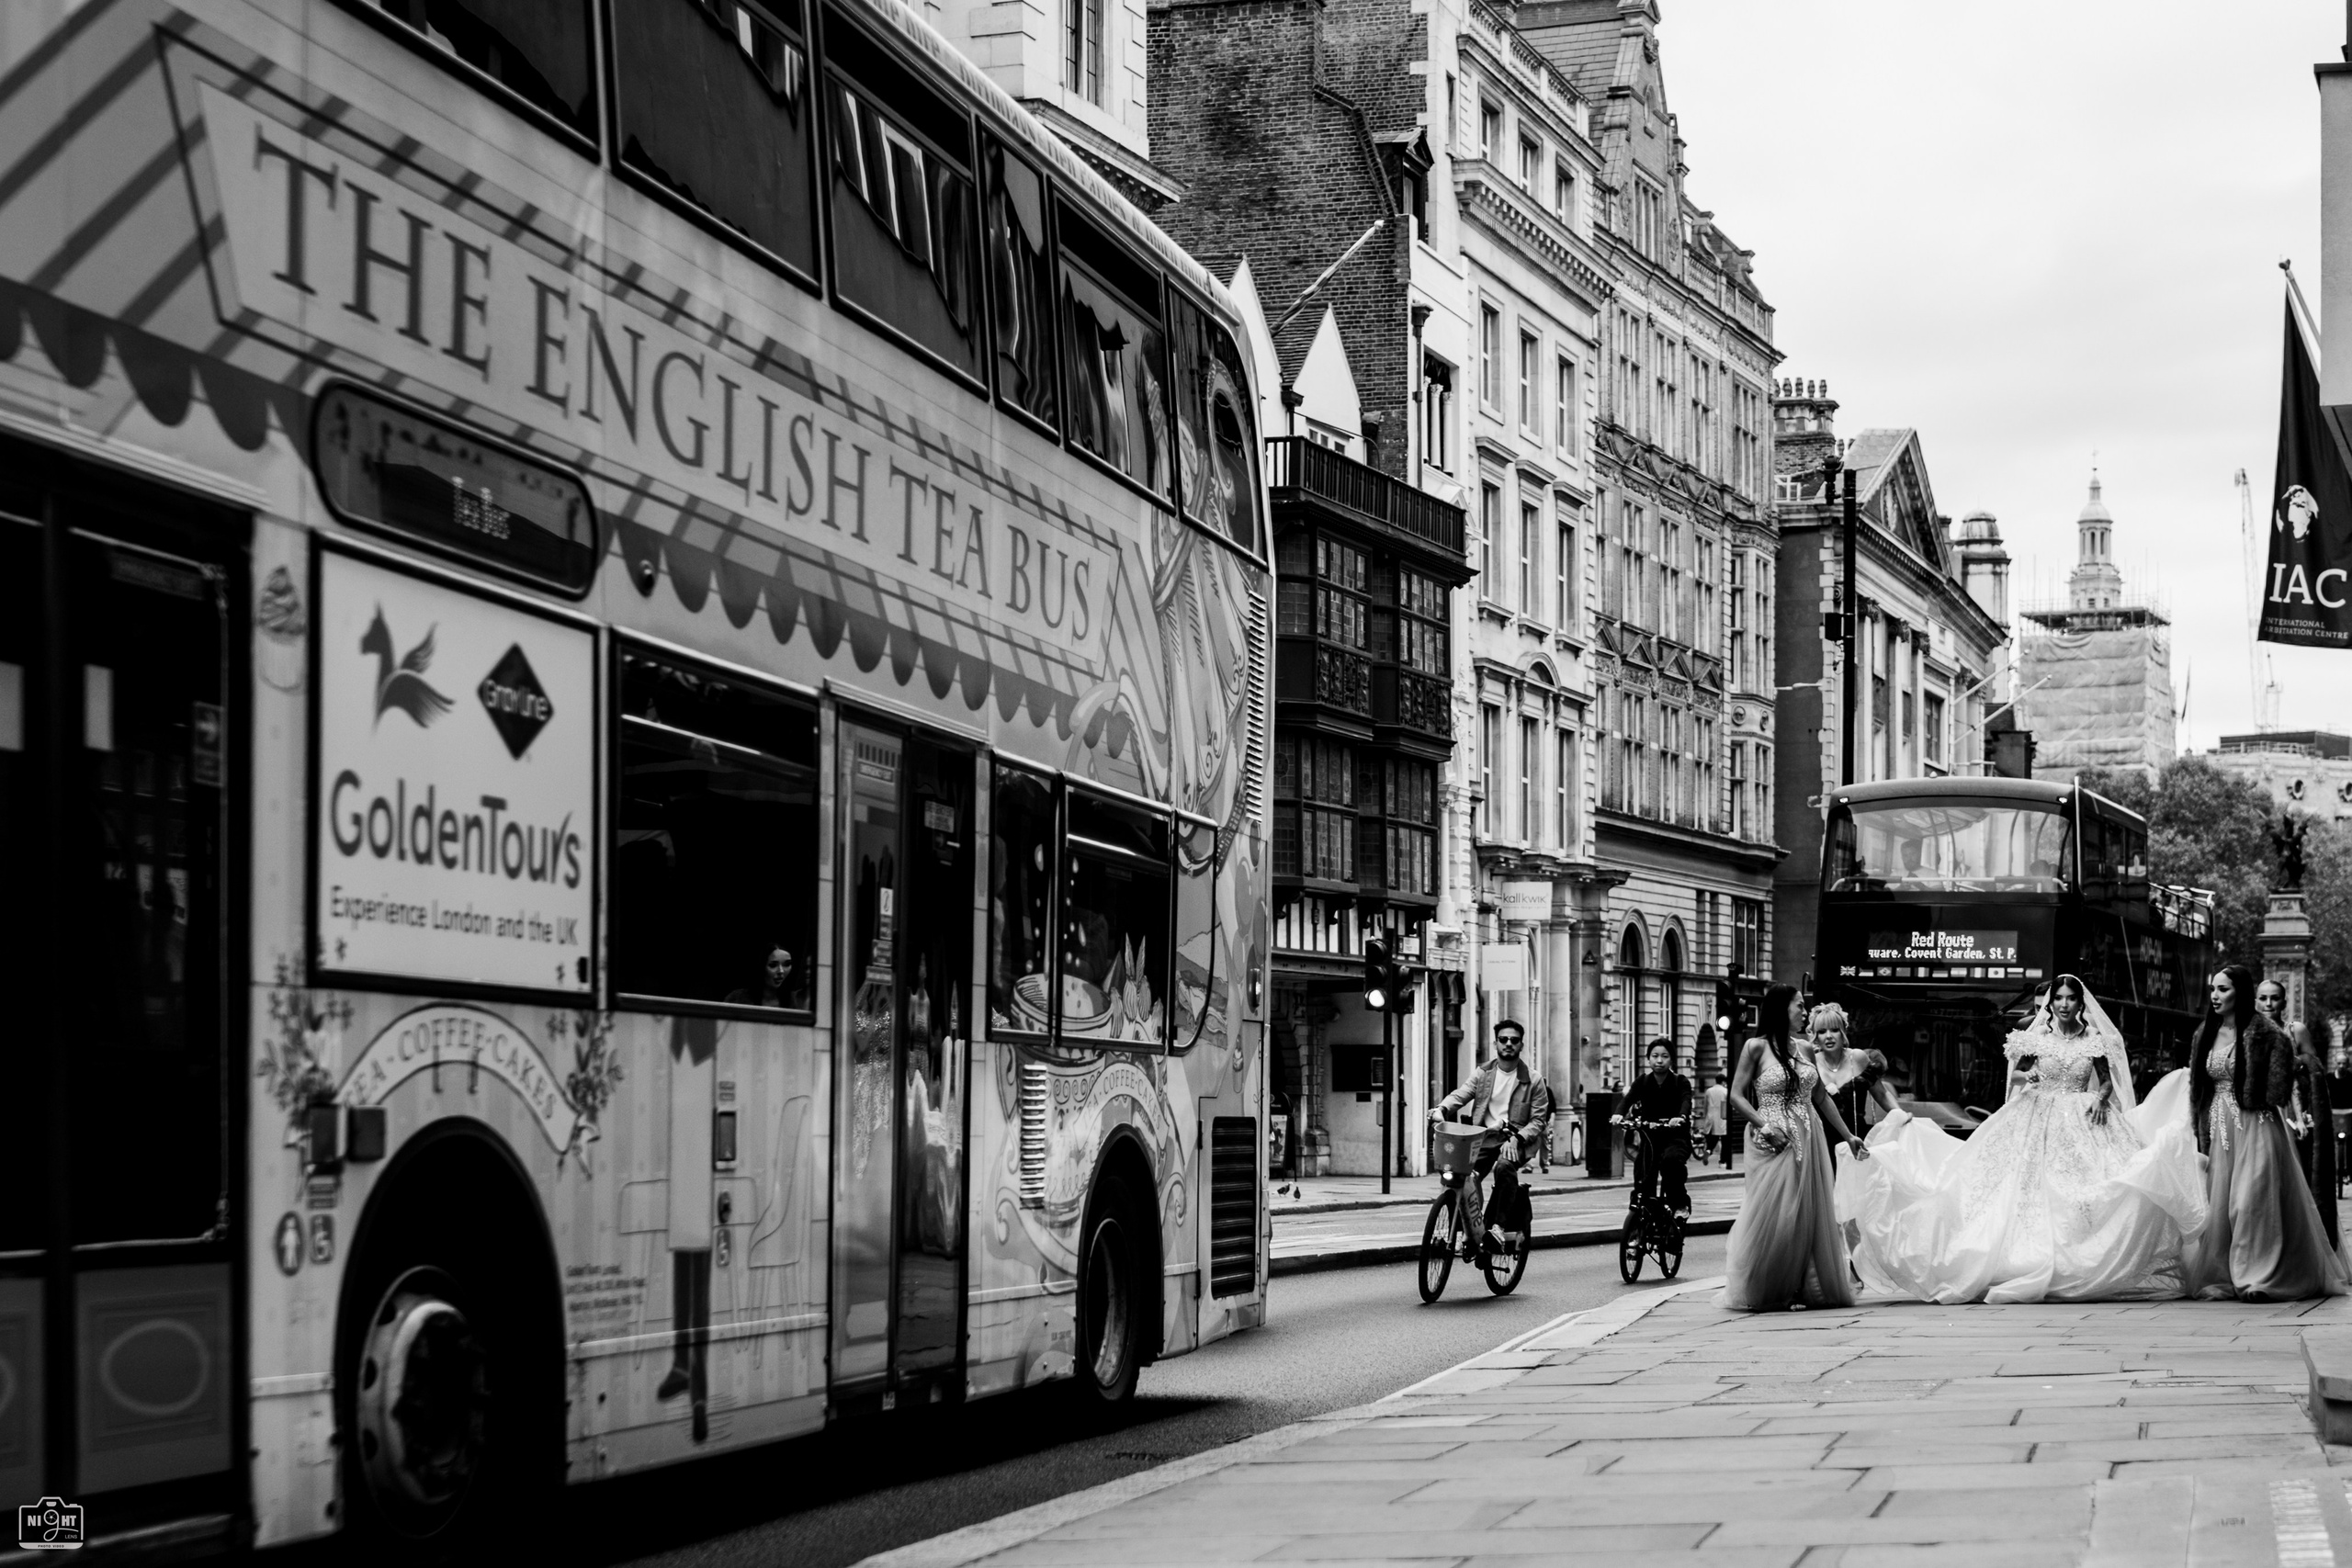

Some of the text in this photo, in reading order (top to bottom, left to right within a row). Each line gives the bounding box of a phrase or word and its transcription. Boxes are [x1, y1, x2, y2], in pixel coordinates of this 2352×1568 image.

[252, 121, 1091, 646] THE ENGLISH TEA BUS
[2268, 562, 2347, 609] IAC
[2315, 629, 2349, 639] CENTRE
[330, 885, 578, 946] Experience London and the UK
[1905, 946, 1942, 959] Covent
[1945, 946, 1986, 960] Garden,
[1989, 947, 2004, 960] St.
[1911, 931, 1974, 947] Red Route
[492, 1032, 557, 1120] CAKES
[1103, 1068, 1135, 1095] COFFEE
